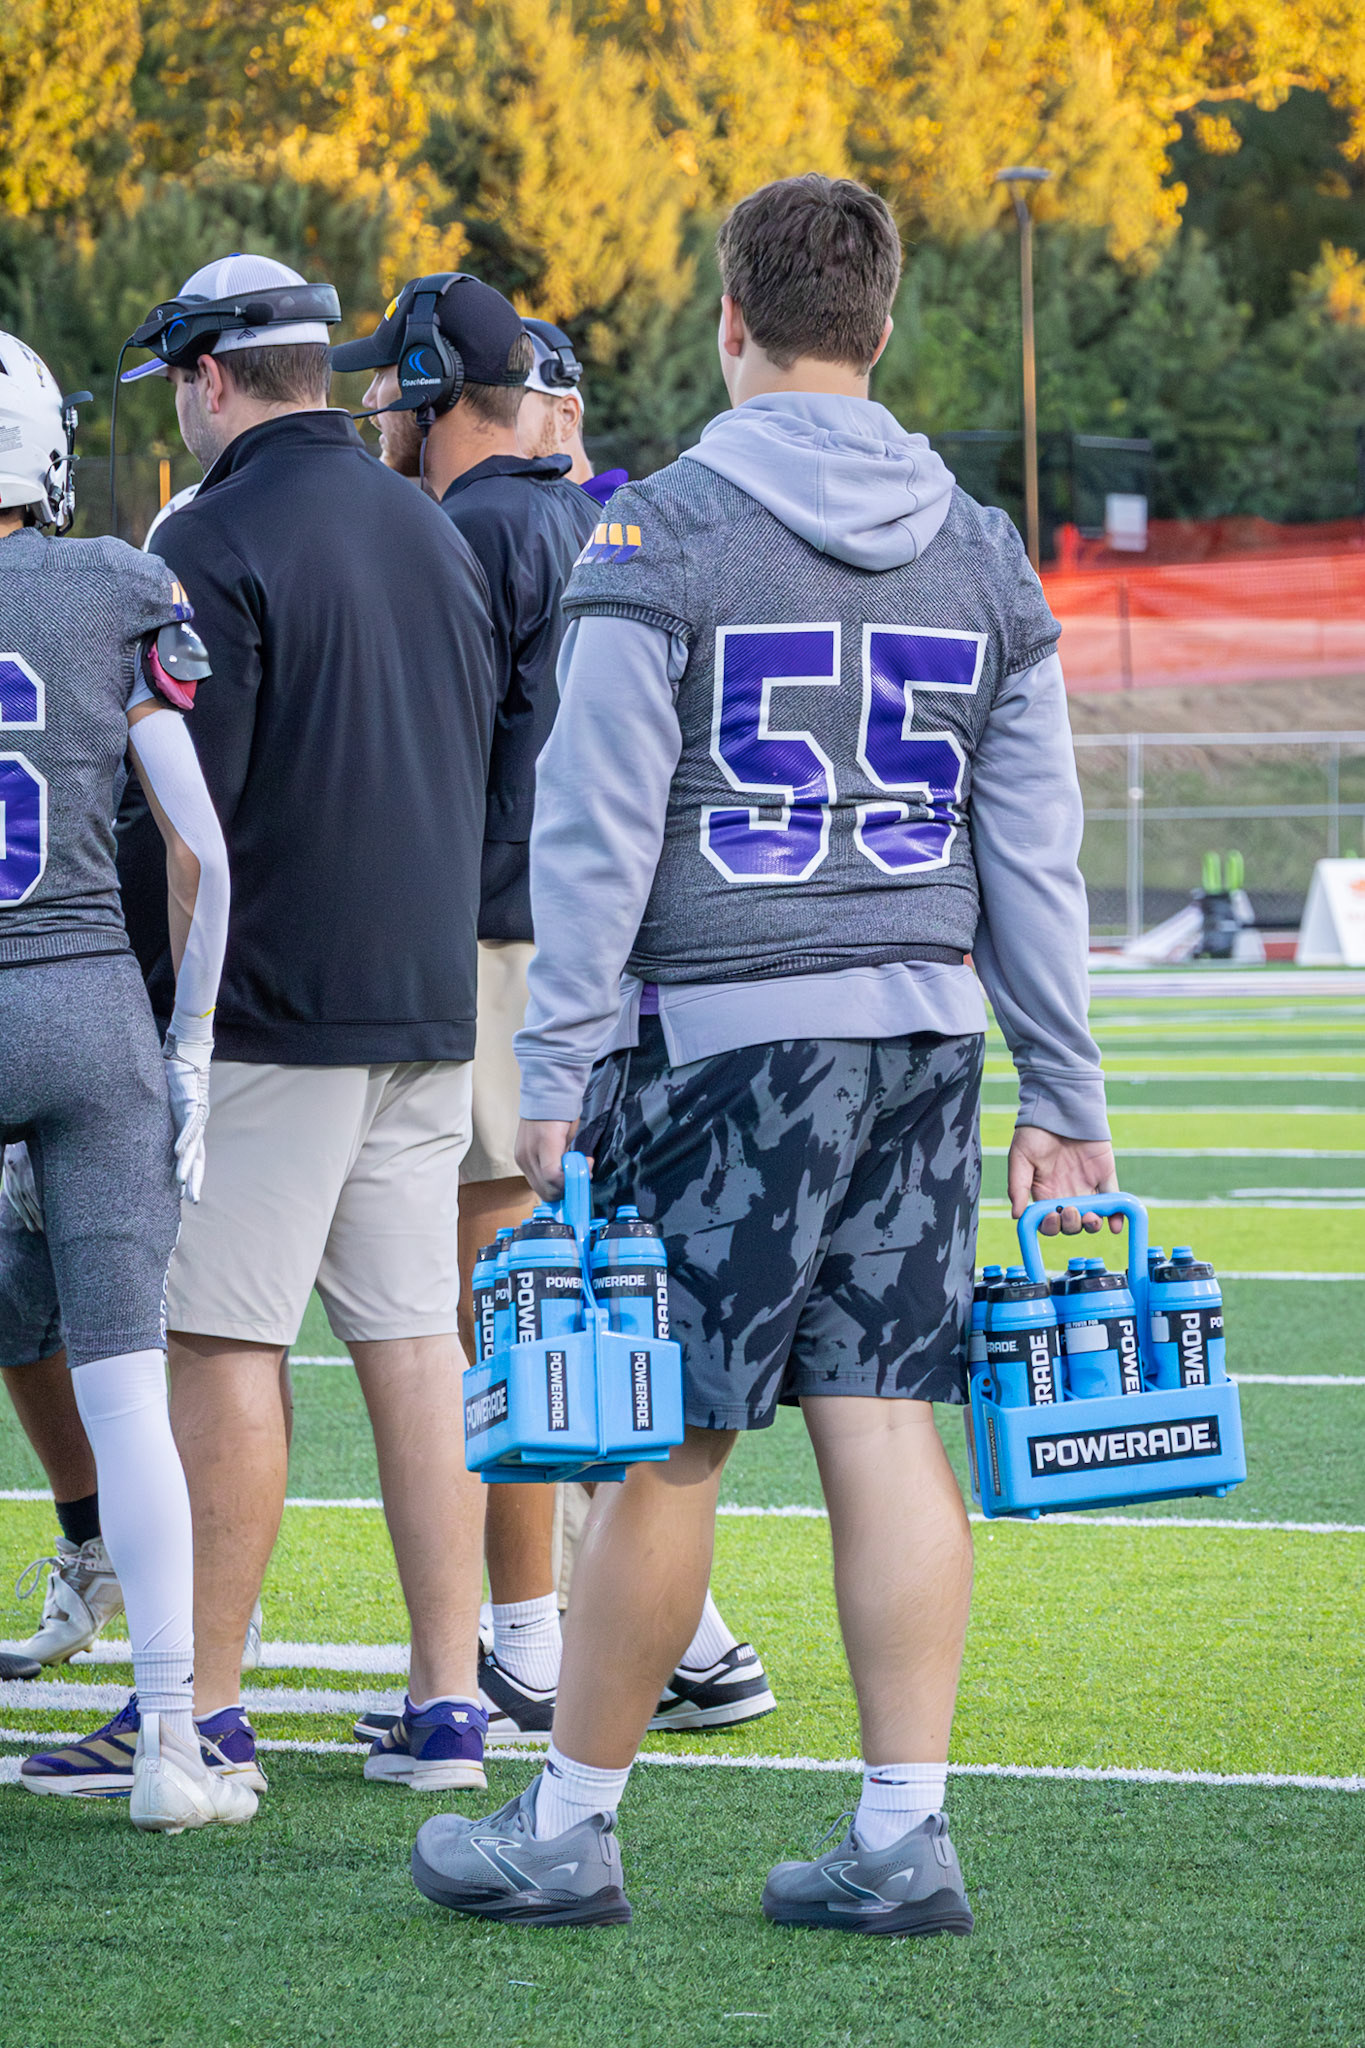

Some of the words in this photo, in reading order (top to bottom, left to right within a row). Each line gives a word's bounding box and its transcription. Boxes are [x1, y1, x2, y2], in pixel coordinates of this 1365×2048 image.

[402, 377, 441, 387] CoachComm
[700, 621, 988, 883] 55
[1119, 1319, 1141, 1395] POWE
[1181, 1312, 1206, 1388] POWE
[466, 1386, 508, 1432] POWERADE
[550, 1352, 565, 1430] POWERADE
[634, 1352, 649, 1430] POWERADE
